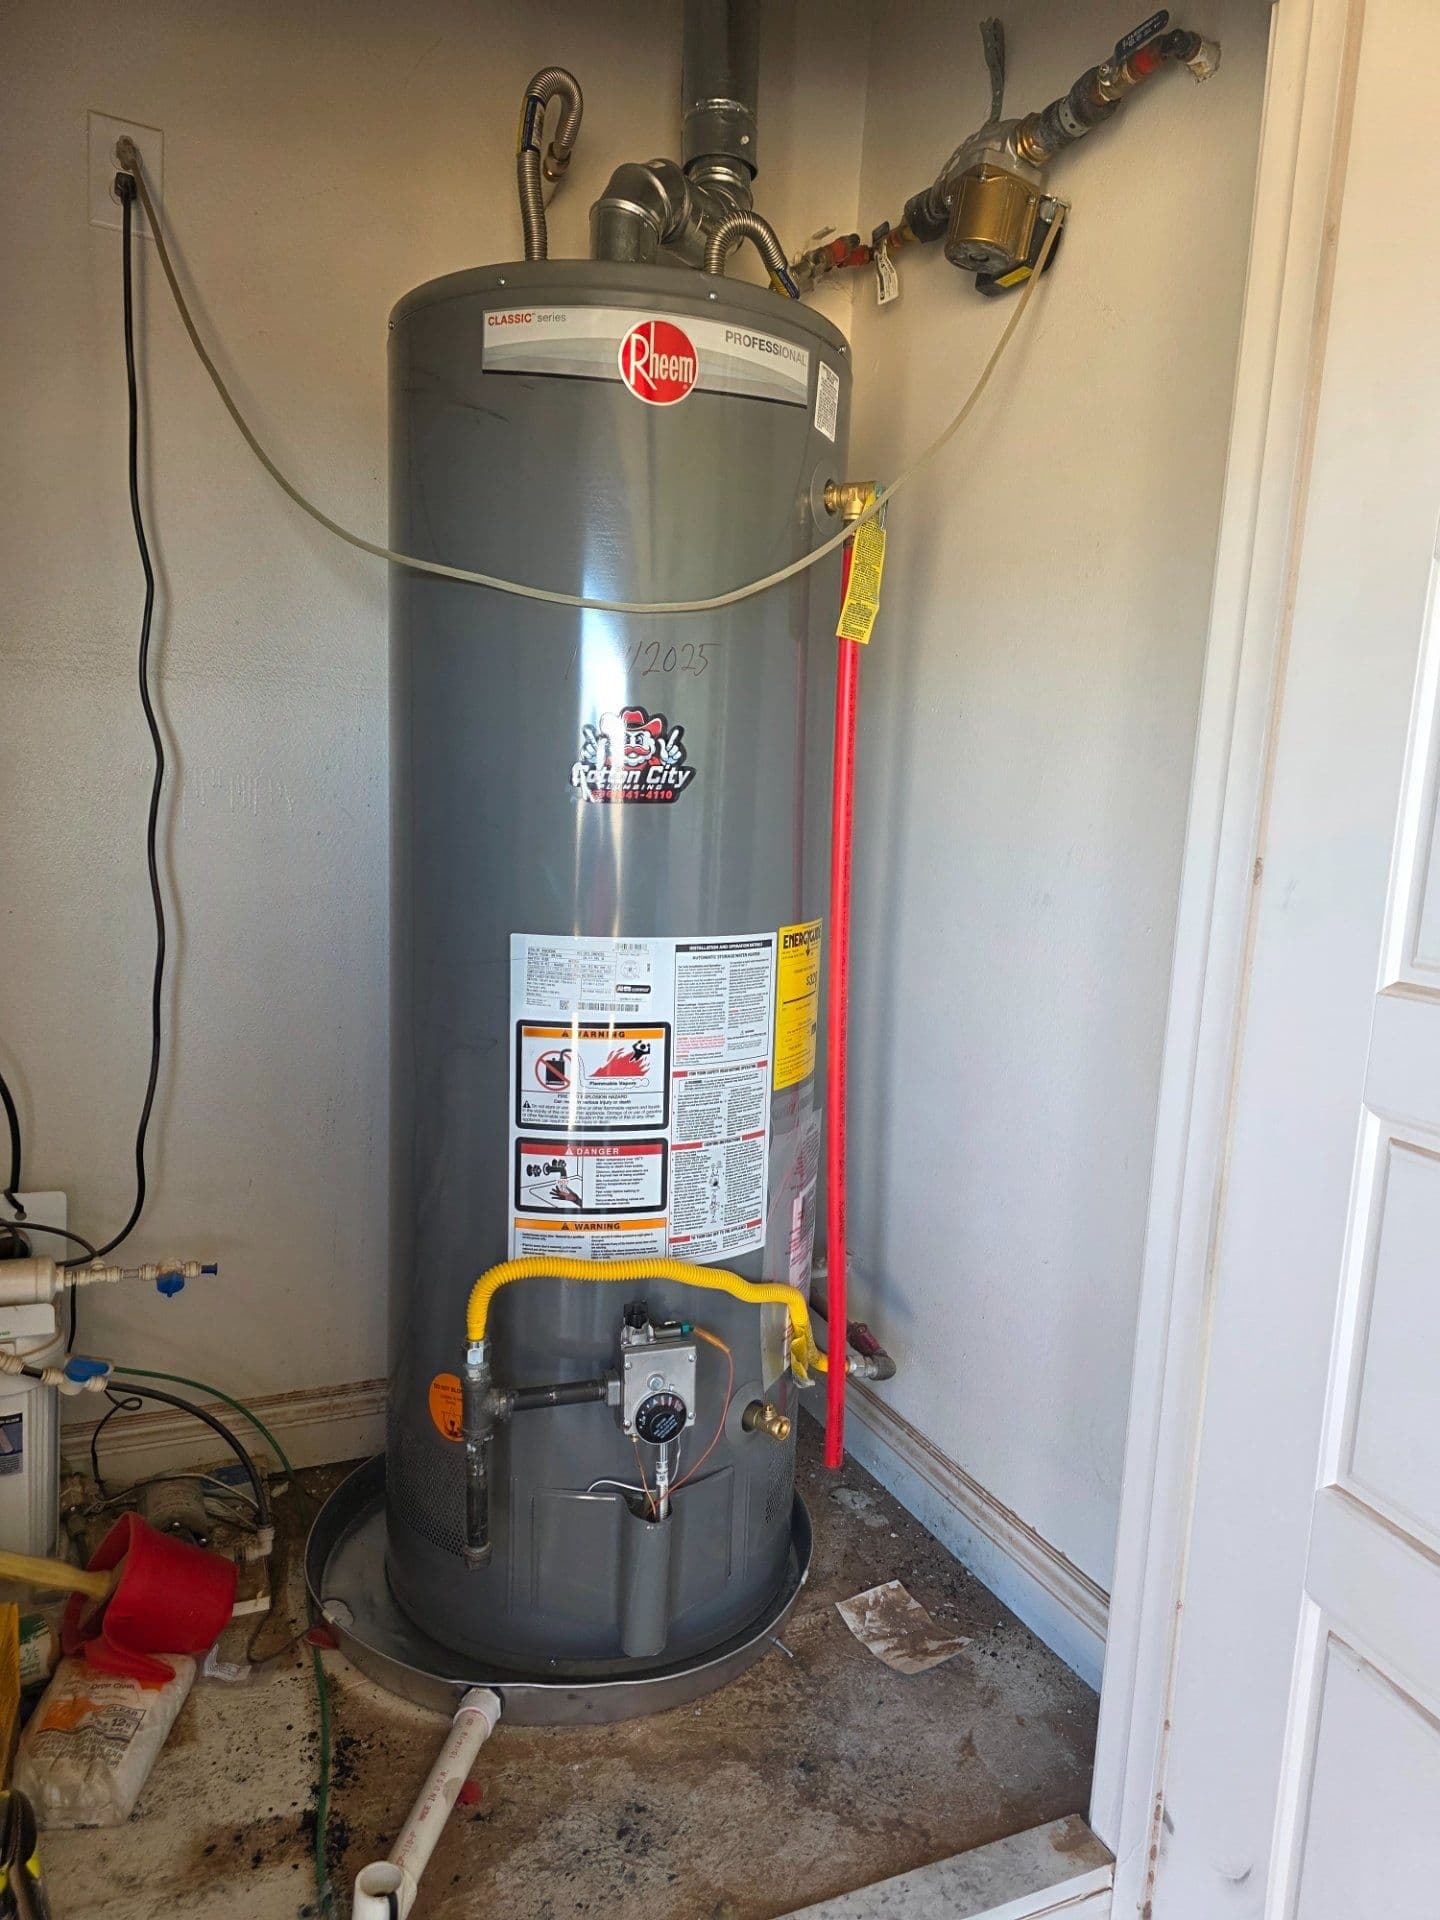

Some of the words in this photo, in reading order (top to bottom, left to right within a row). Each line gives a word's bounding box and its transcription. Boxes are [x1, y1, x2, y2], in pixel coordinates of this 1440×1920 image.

[488, 313, 532, 326] CLASSIC
[537, 312, 567, 323] series
[725, 330, 807, 367] PROFESSIONAL
[630, 321, 694, 391] Rheem
[646, 764, 692, 789] City
[574, 1030, 626, 1038] ARNIG
[576, 1147, 620, 1156] DANGER
[574, 1222, 621, 1231] WARNING
[106, 1705, 139, 1717] CLEAR
[428, 1790, 437, 1802] IN
